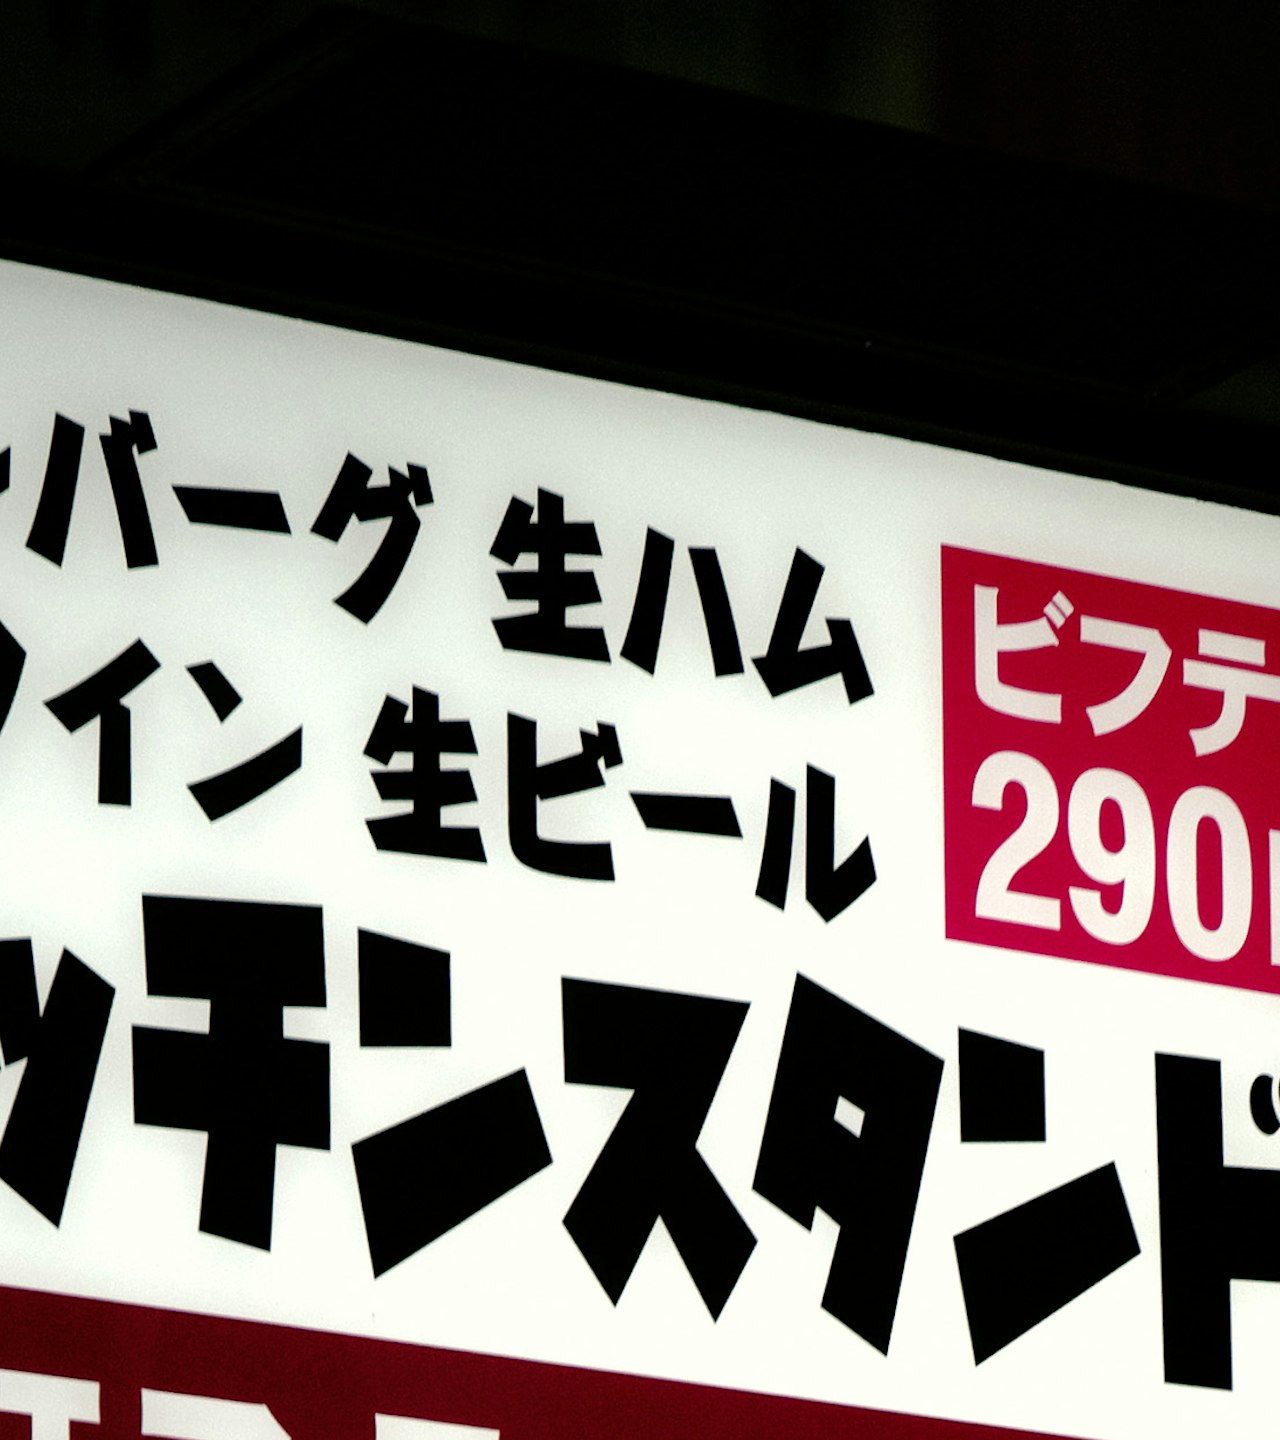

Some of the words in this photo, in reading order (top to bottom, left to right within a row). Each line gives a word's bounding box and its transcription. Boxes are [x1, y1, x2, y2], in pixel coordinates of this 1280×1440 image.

[490, 488, 874, 704] 生ハム
[364, 686, 876, 922] 生ビール
